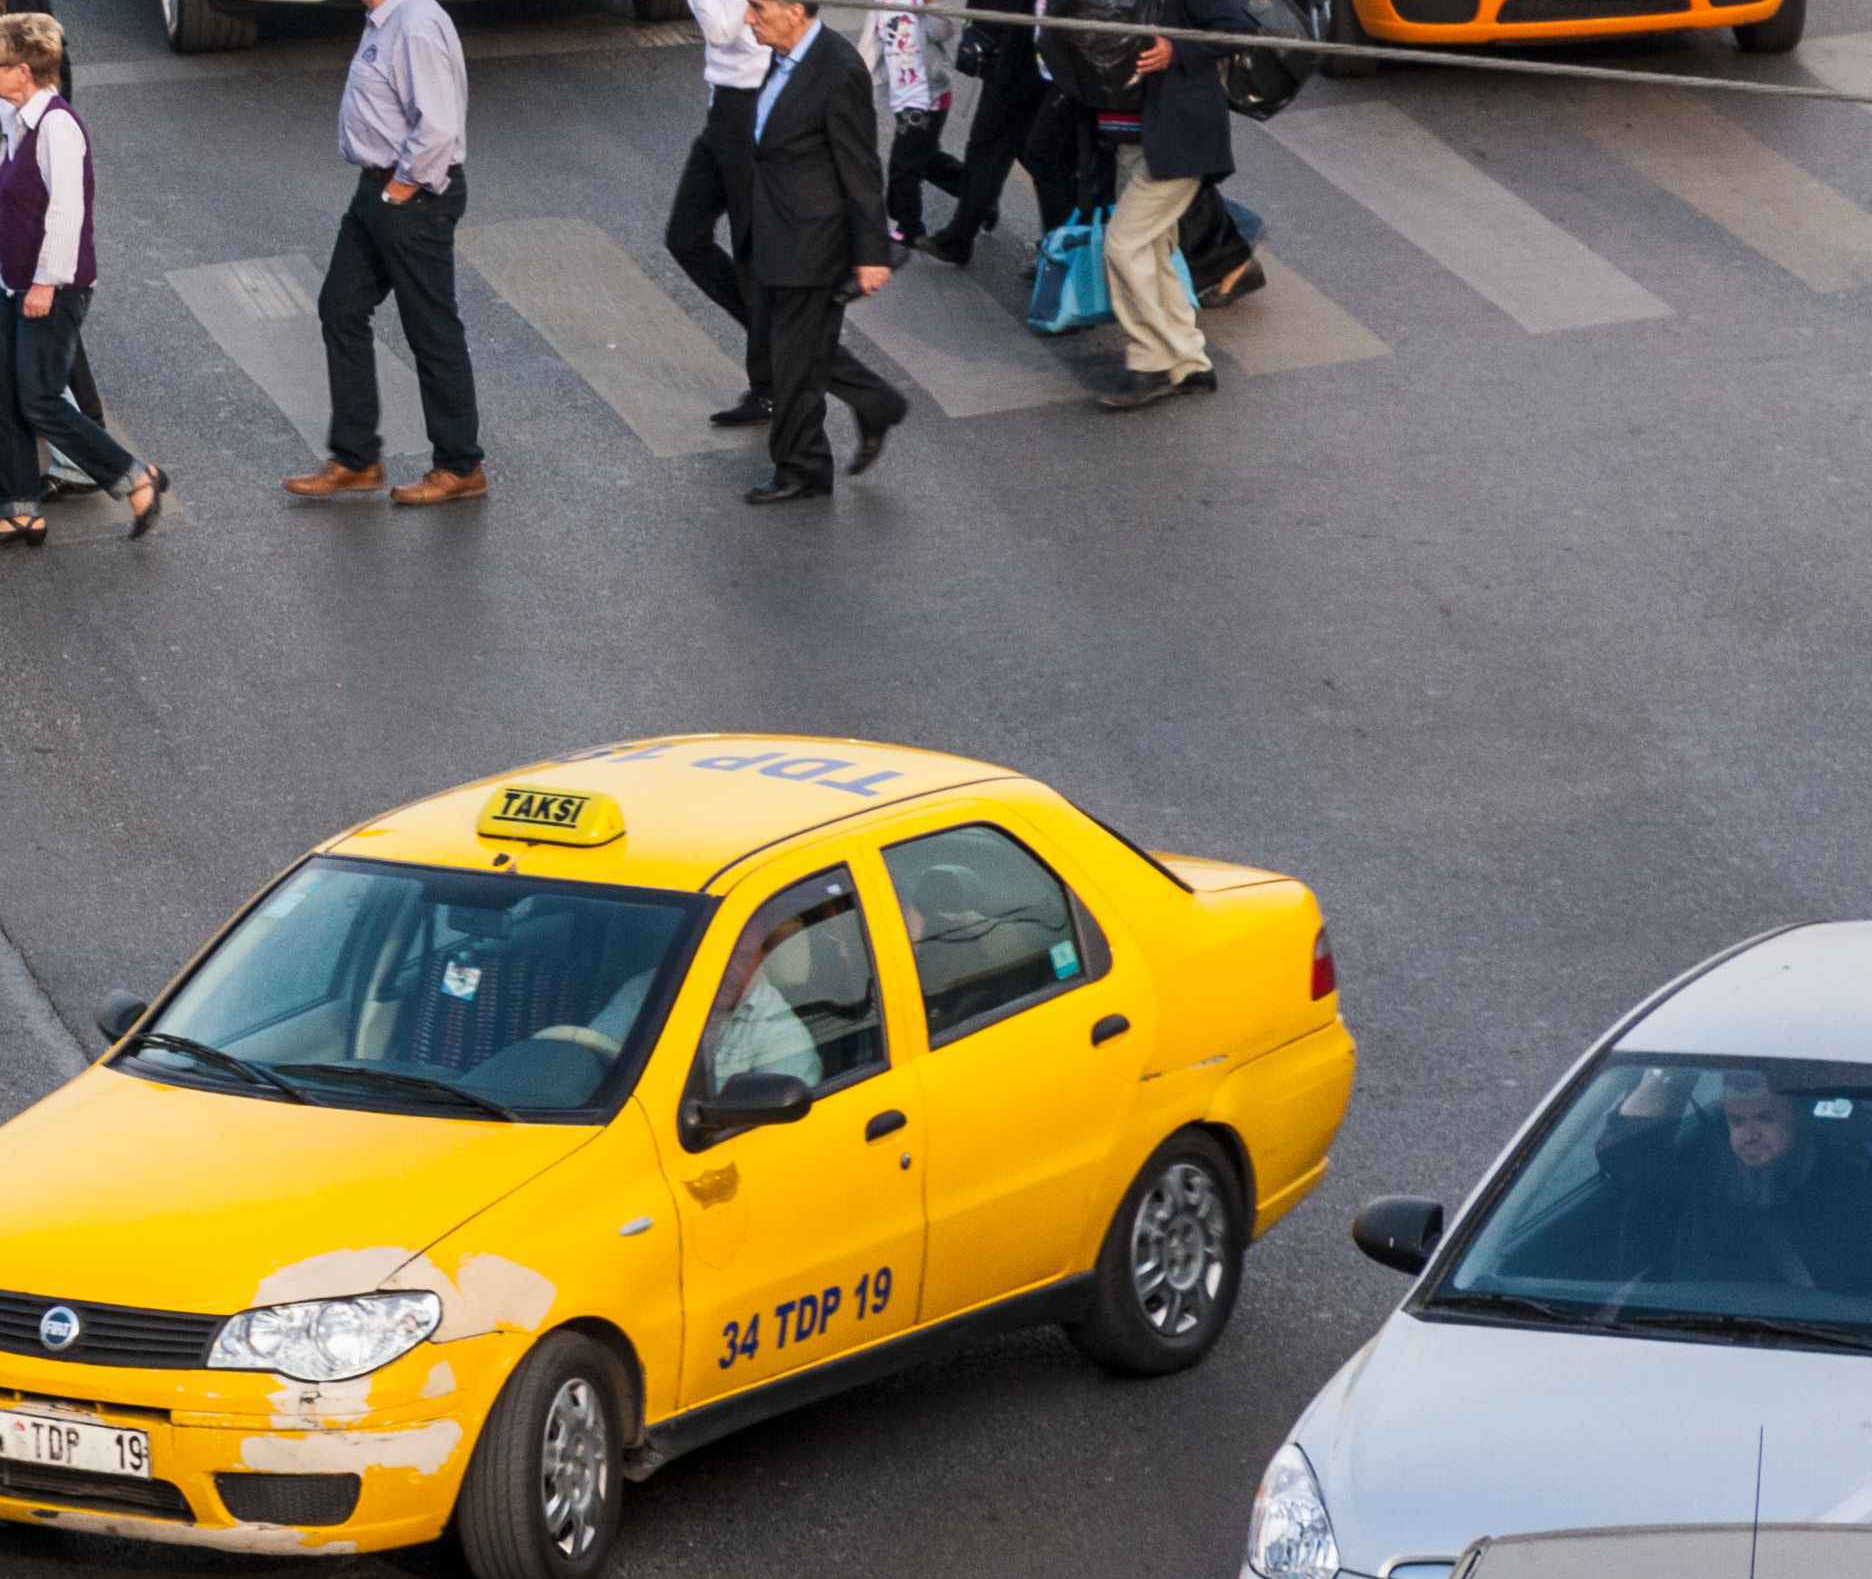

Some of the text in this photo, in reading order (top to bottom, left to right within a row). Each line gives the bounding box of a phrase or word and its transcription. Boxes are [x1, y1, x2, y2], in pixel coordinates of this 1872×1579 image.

[719, 1265, 894, 1370] 34 TDP 19
[32, 1422, 80, 1464] TDP
[116, 1430, 145, 1471] 19
